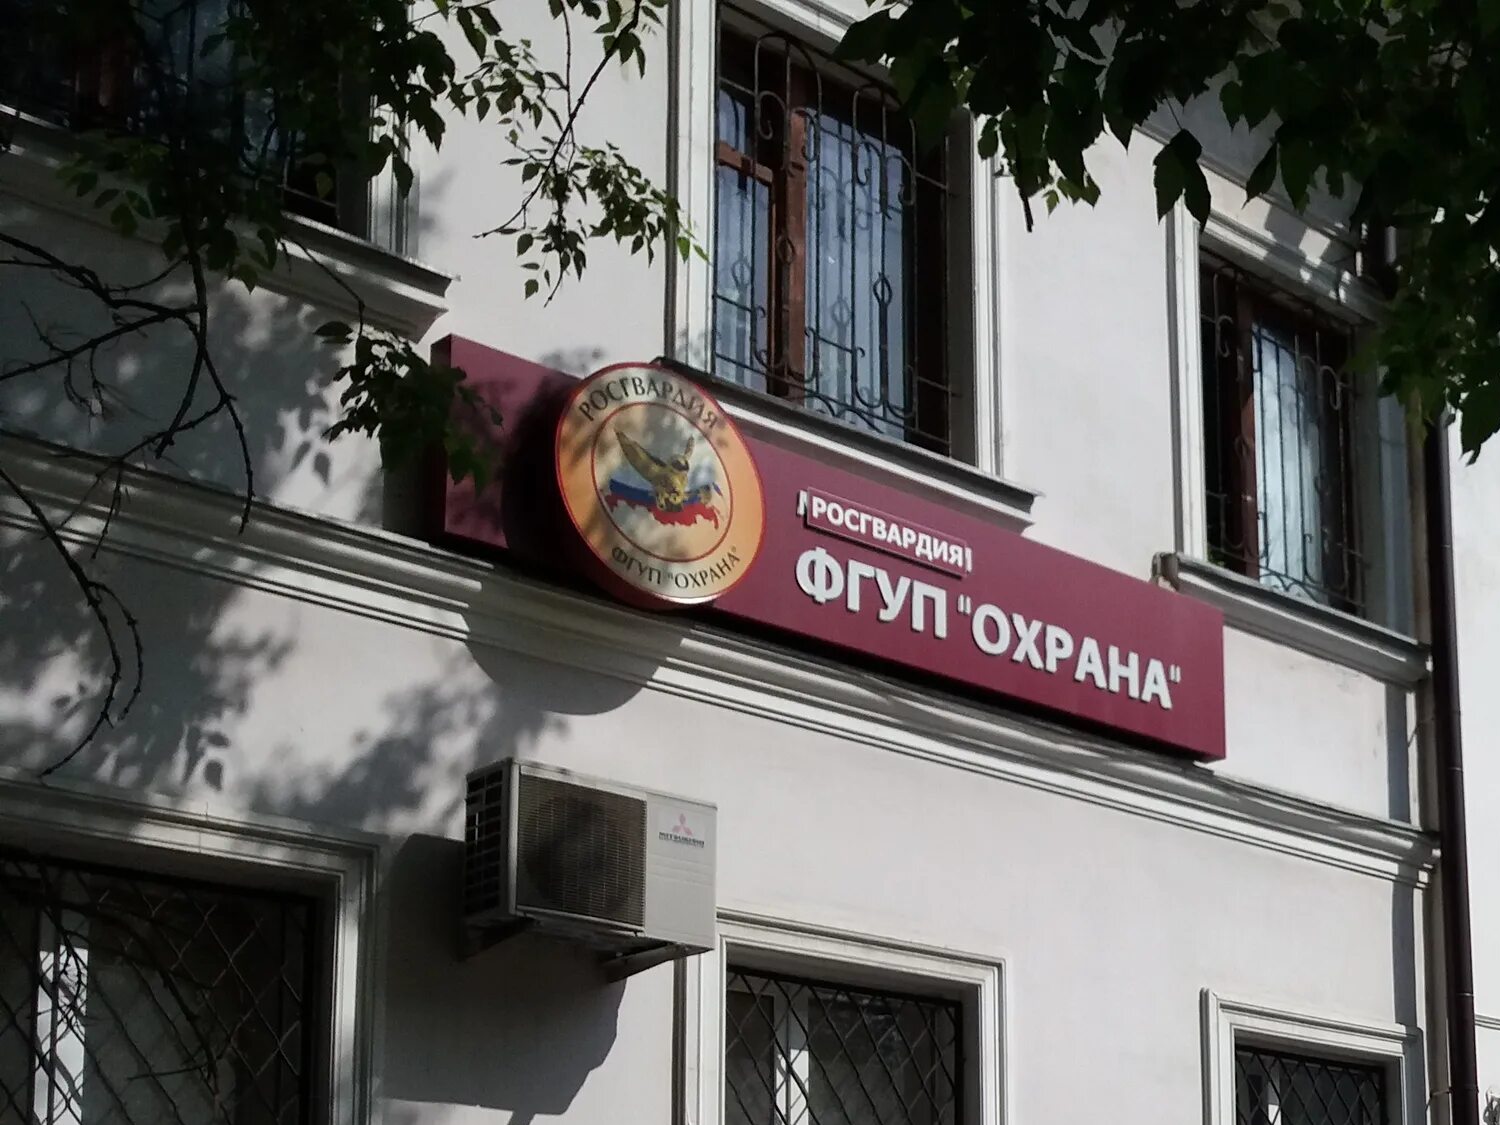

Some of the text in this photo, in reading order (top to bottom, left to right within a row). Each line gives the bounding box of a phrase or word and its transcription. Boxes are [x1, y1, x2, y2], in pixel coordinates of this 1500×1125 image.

[578, 376, 719, 430] РОСГВАРДИЯ
[811, 495, 964, 570] РОСГВАРДИЯ
[611, 546, 662, 585] ФГУП
[795, 546, 948, 640] ФГУП
